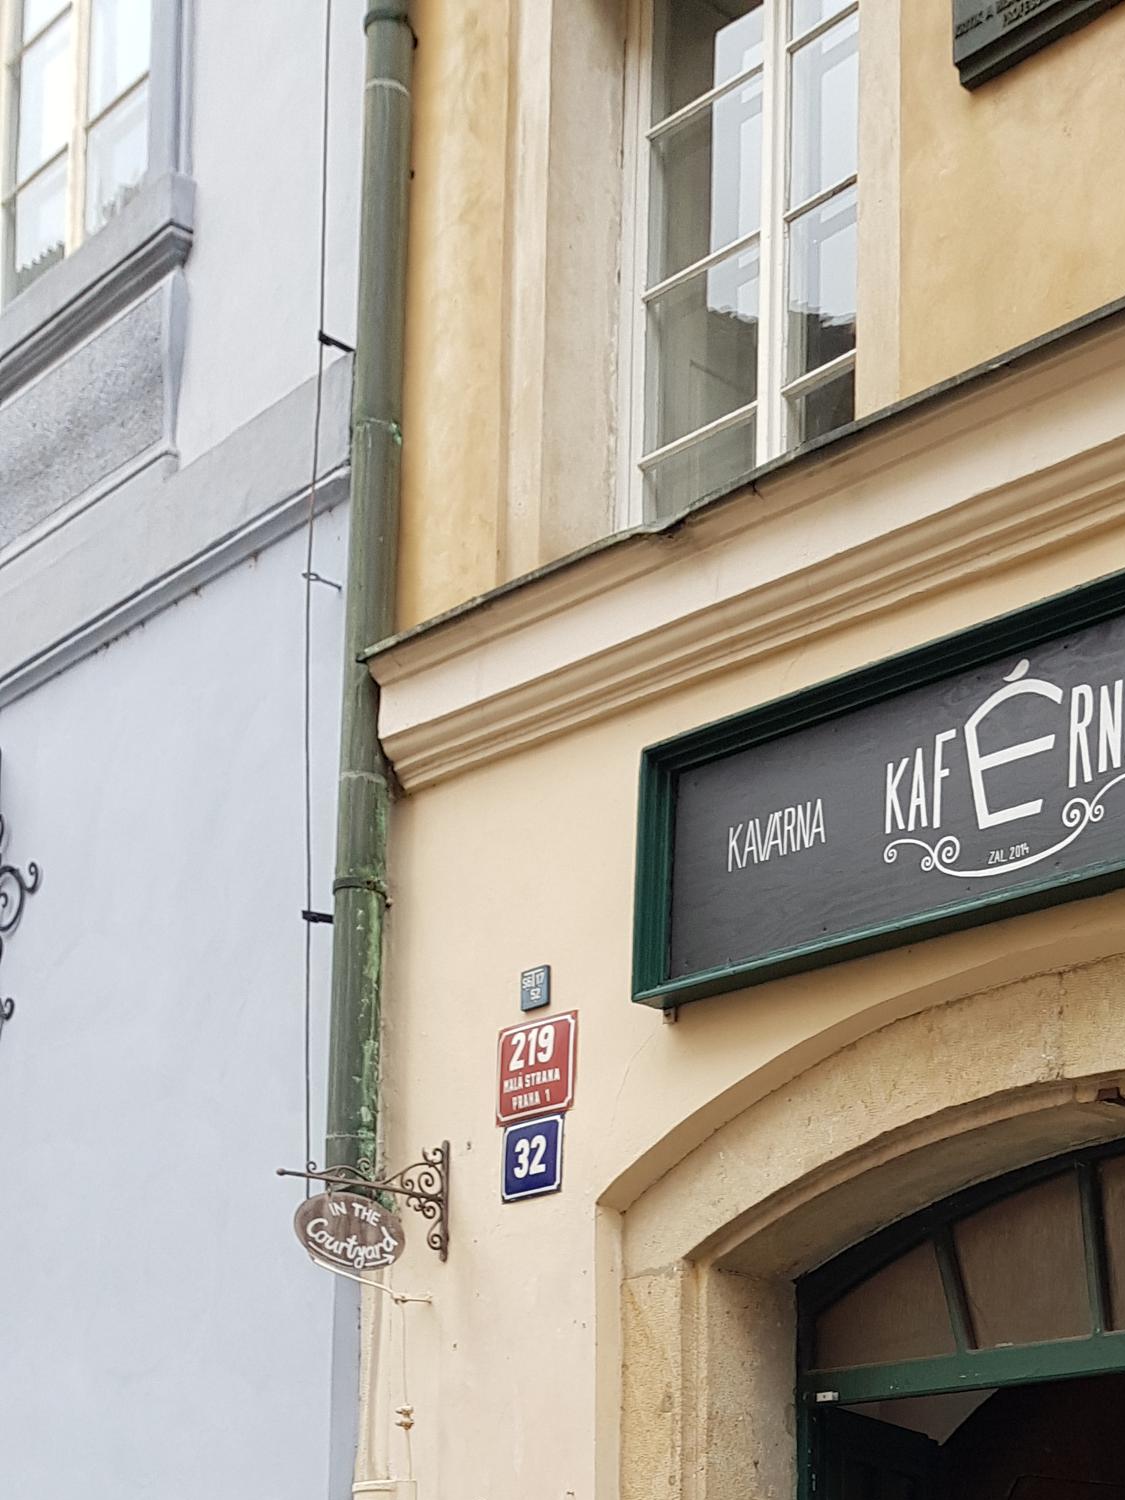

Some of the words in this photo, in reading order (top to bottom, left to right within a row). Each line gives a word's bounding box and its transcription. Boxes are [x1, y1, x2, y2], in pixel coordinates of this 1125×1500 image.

[1009, 842, 1030, 860] 2014
[508, 1023, 556, 1073] 219
[503, 1072, 524, 1094] MALÁ
[524, 1067, 561, 1088] STRANA
[511, 1090, 541, 1111] PRAHA
[544, 1088, 551, 1102] 1
[513, 1134, 547, 1179] 32
[328, 1201, 347, 1217] IN
[351, 1202, 382, 1227] THE
[306, 1217, 399, 1269] Courtyard
